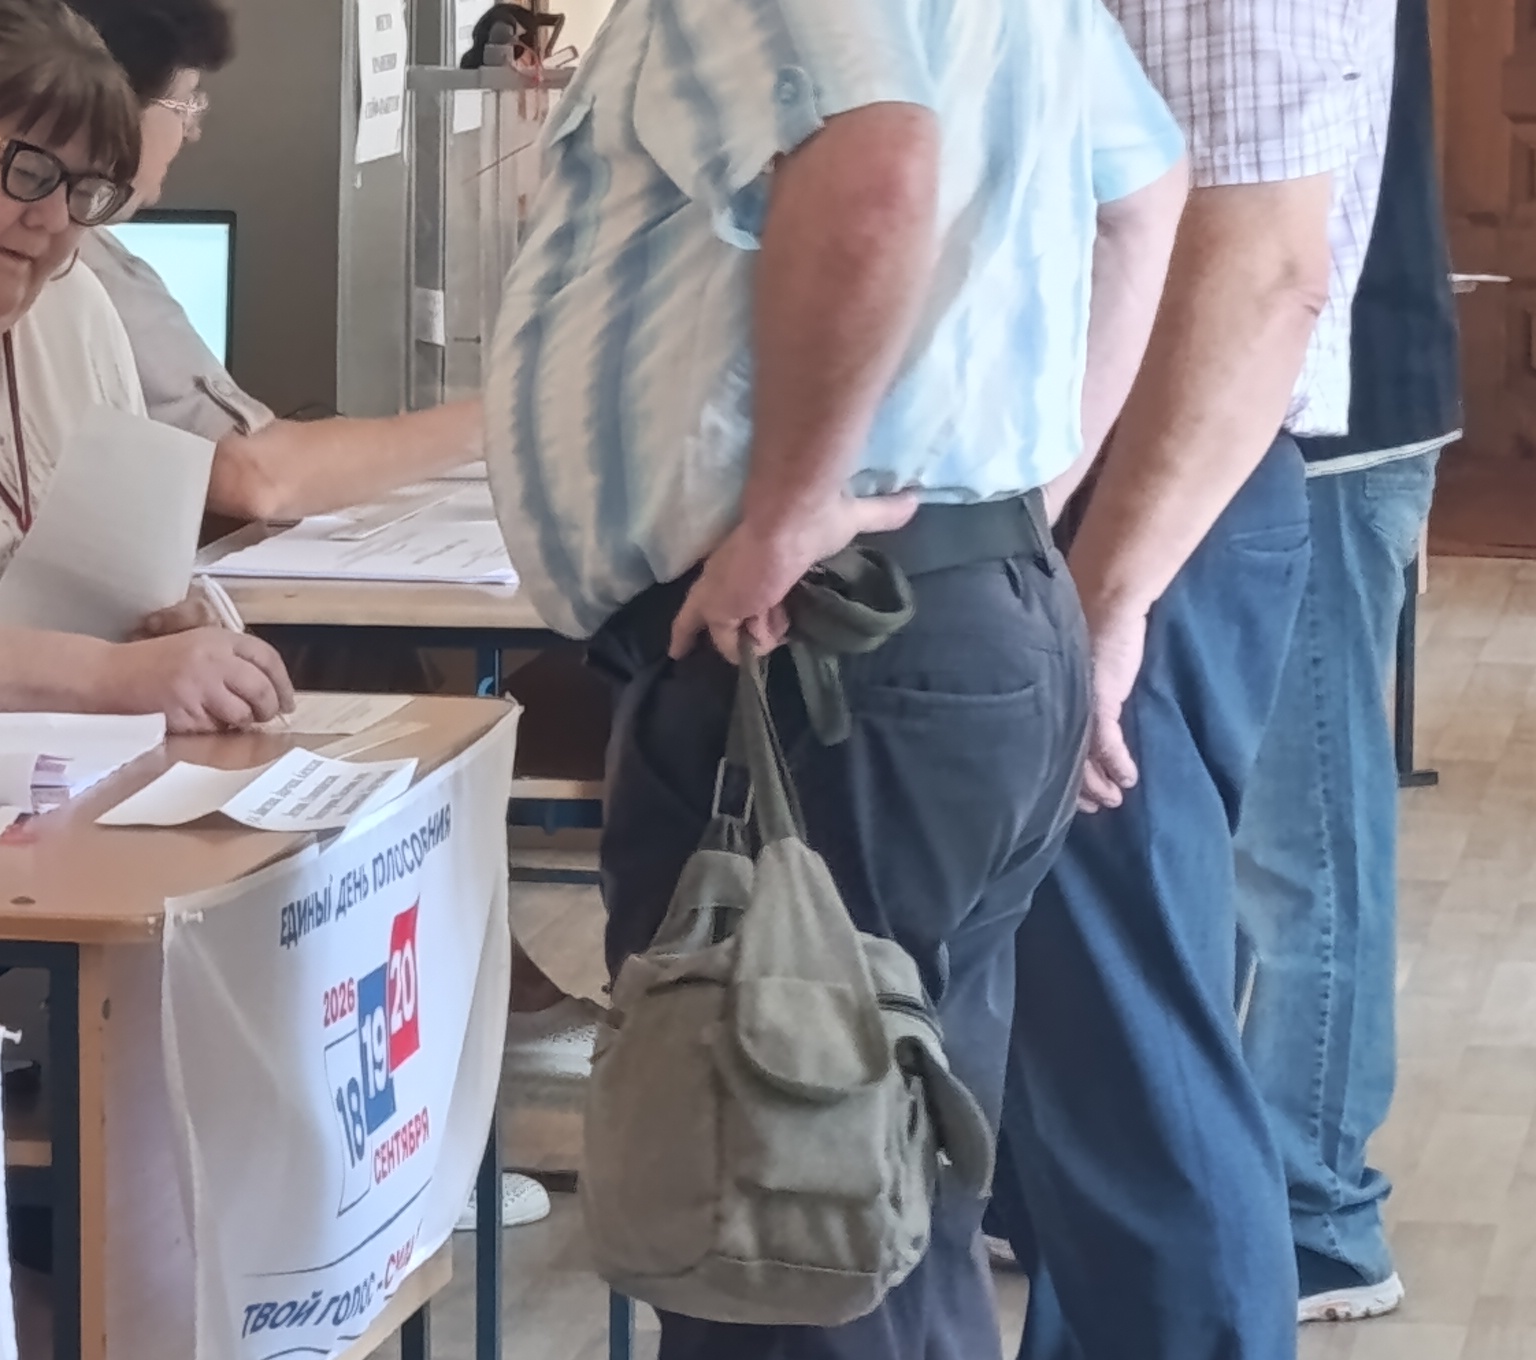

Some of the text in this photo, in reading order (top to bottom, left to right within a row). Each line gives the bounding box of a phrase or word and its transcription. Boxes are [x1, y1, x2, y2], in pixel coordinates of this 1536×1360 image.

[280, 874, 333, 949] ЕДИНЫЙ
[335, 863, 368, 922] ДЕНЬ
[323, 977, 355, 1028] 2026
[390, 938, 415, 1032] 20
[361, 1005, 388, 1099] 19
[336, 1076, 364, 1169] 18
[374, 1106, 430, 1185] СЕНТЯБРЯ
[242, 1290, 324, 1339] ТВОЙ
